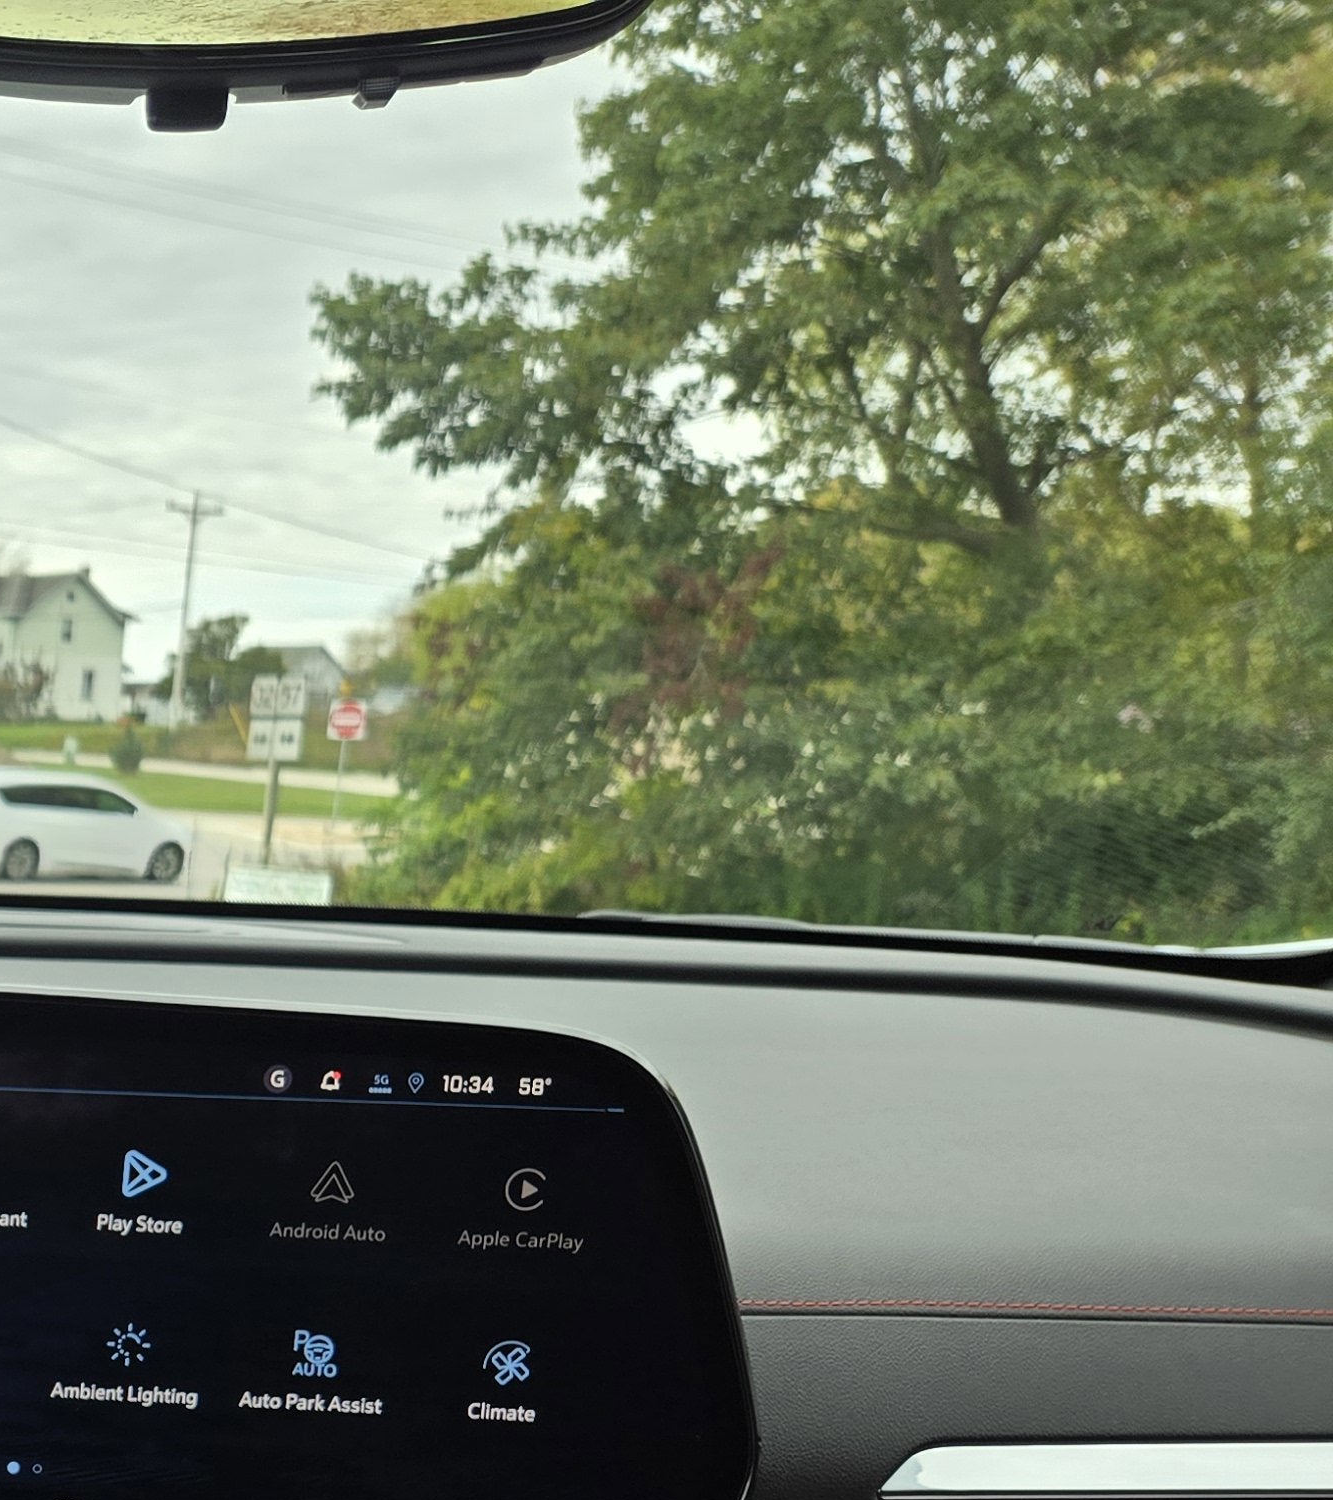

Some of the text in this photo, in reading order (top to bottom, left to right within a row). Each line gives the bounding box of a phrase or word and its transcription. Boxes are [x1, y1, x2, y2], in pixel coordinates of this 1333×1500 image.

[373, 1073, 390, 1086] 5G
[442, 1074, 552, 1096] 10:34 58°
[96, 1213, 184, 1236] Play Store
[269, 1221, 386, 1242] Android Auto
[457, 1229, 584, 1254] Apple CarPlay
[292, 1362, 337, 1378] AUTO
[49, 1381, 199, 1410] Ambient Lighting
[238, 1390, 383, 1415] Auto Park Assist
[467, 1401, 536, 1423] Climate
